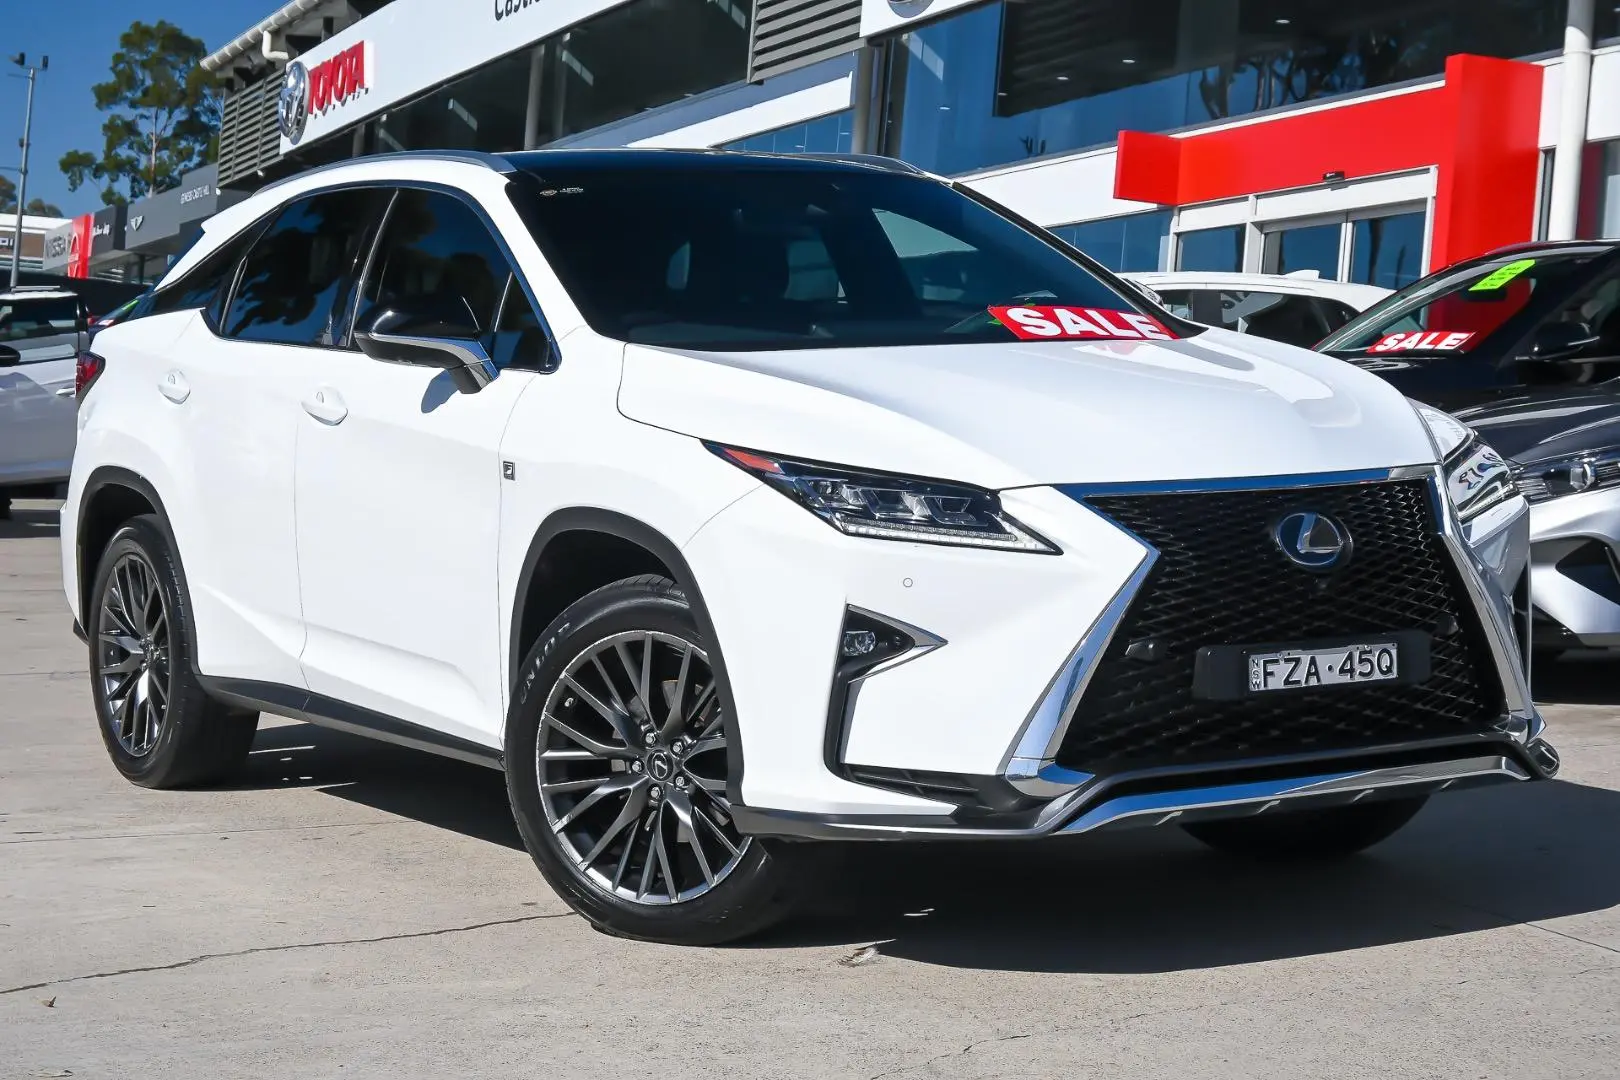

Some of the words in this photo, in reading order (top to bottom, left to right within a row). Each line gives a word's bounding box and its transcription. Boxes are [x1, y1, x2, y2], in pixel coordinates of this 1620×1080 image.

[308, 40, 364, 114] TOYOTA
[1006, 308, 1173, 340] SALE
[1375, 332, 1472, 352] SALE
